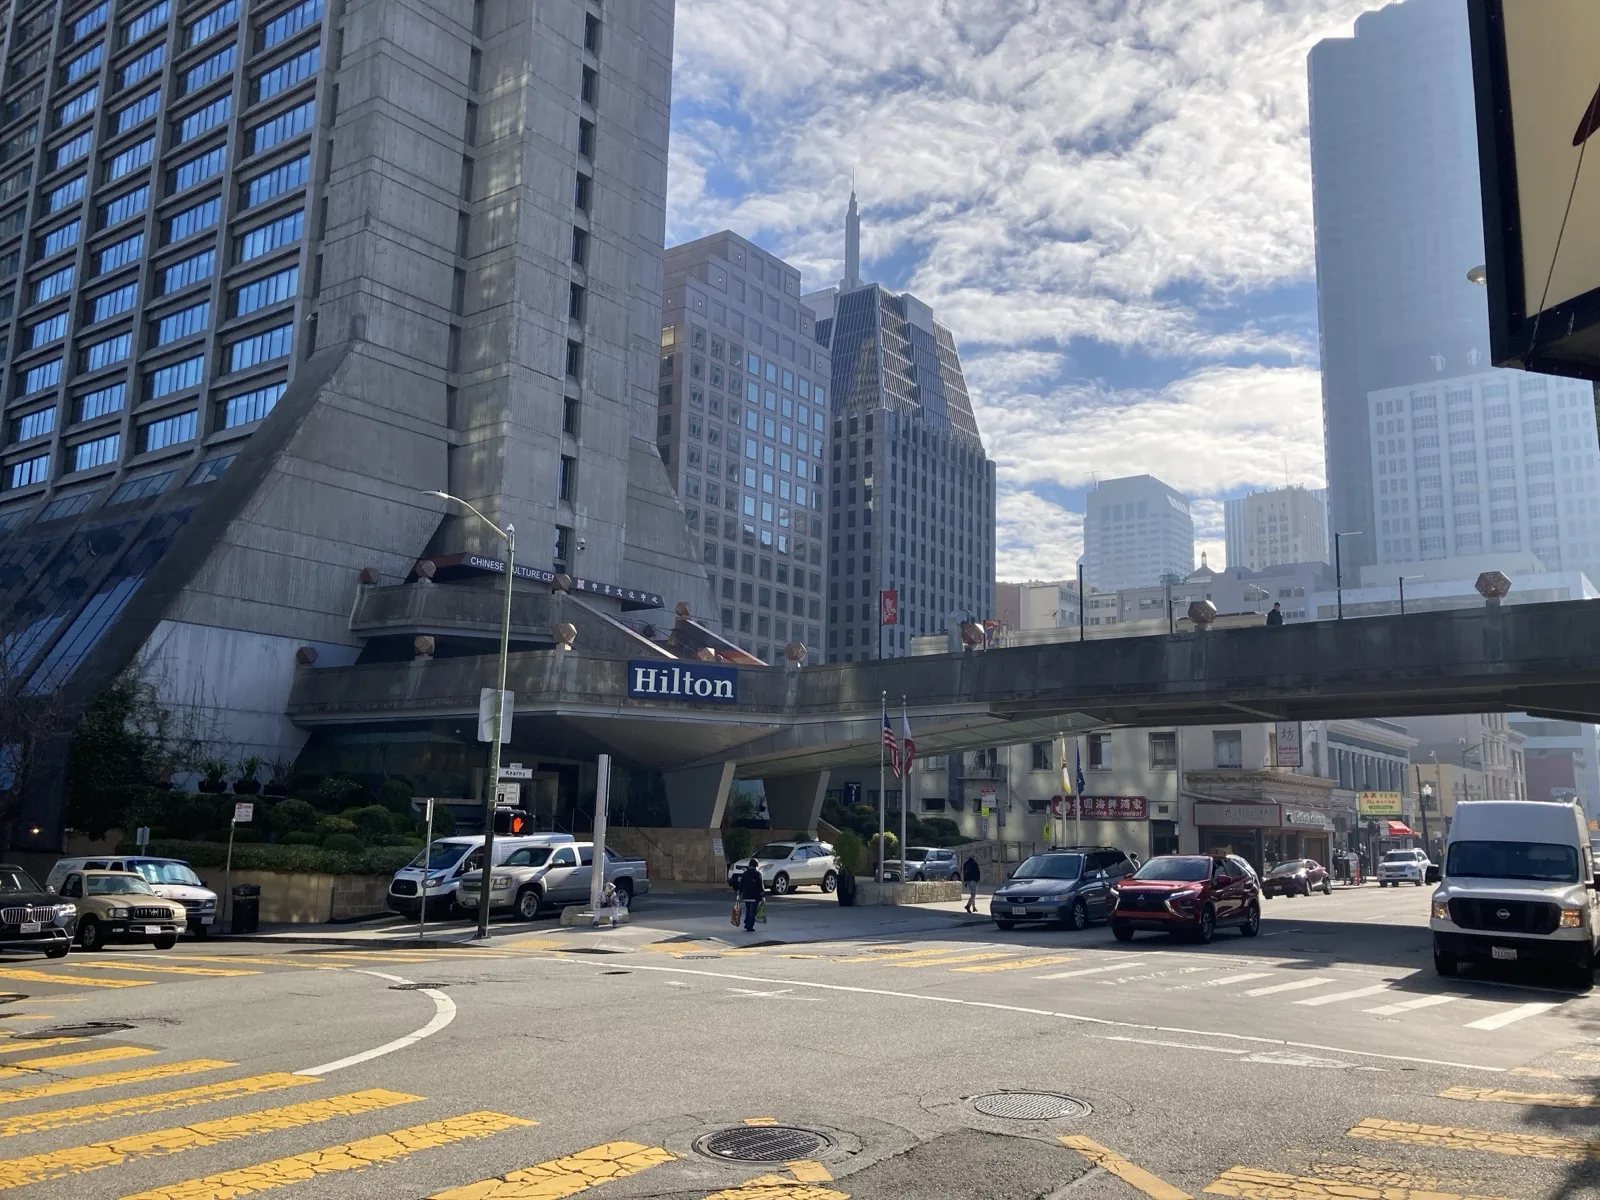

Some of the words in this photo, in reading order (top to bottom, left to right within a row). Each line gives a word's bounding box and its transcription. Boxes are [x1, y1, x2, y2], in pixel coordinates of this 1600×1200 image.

[470, 556, 504, 571] CHINESE
[512, 565, 541, 579] ULTURE
[592, 582, 658, 604] 中華文化中心
[633, 667, 734, 698] Hilton
[1108, 809, 1142, 817] Restaurant
